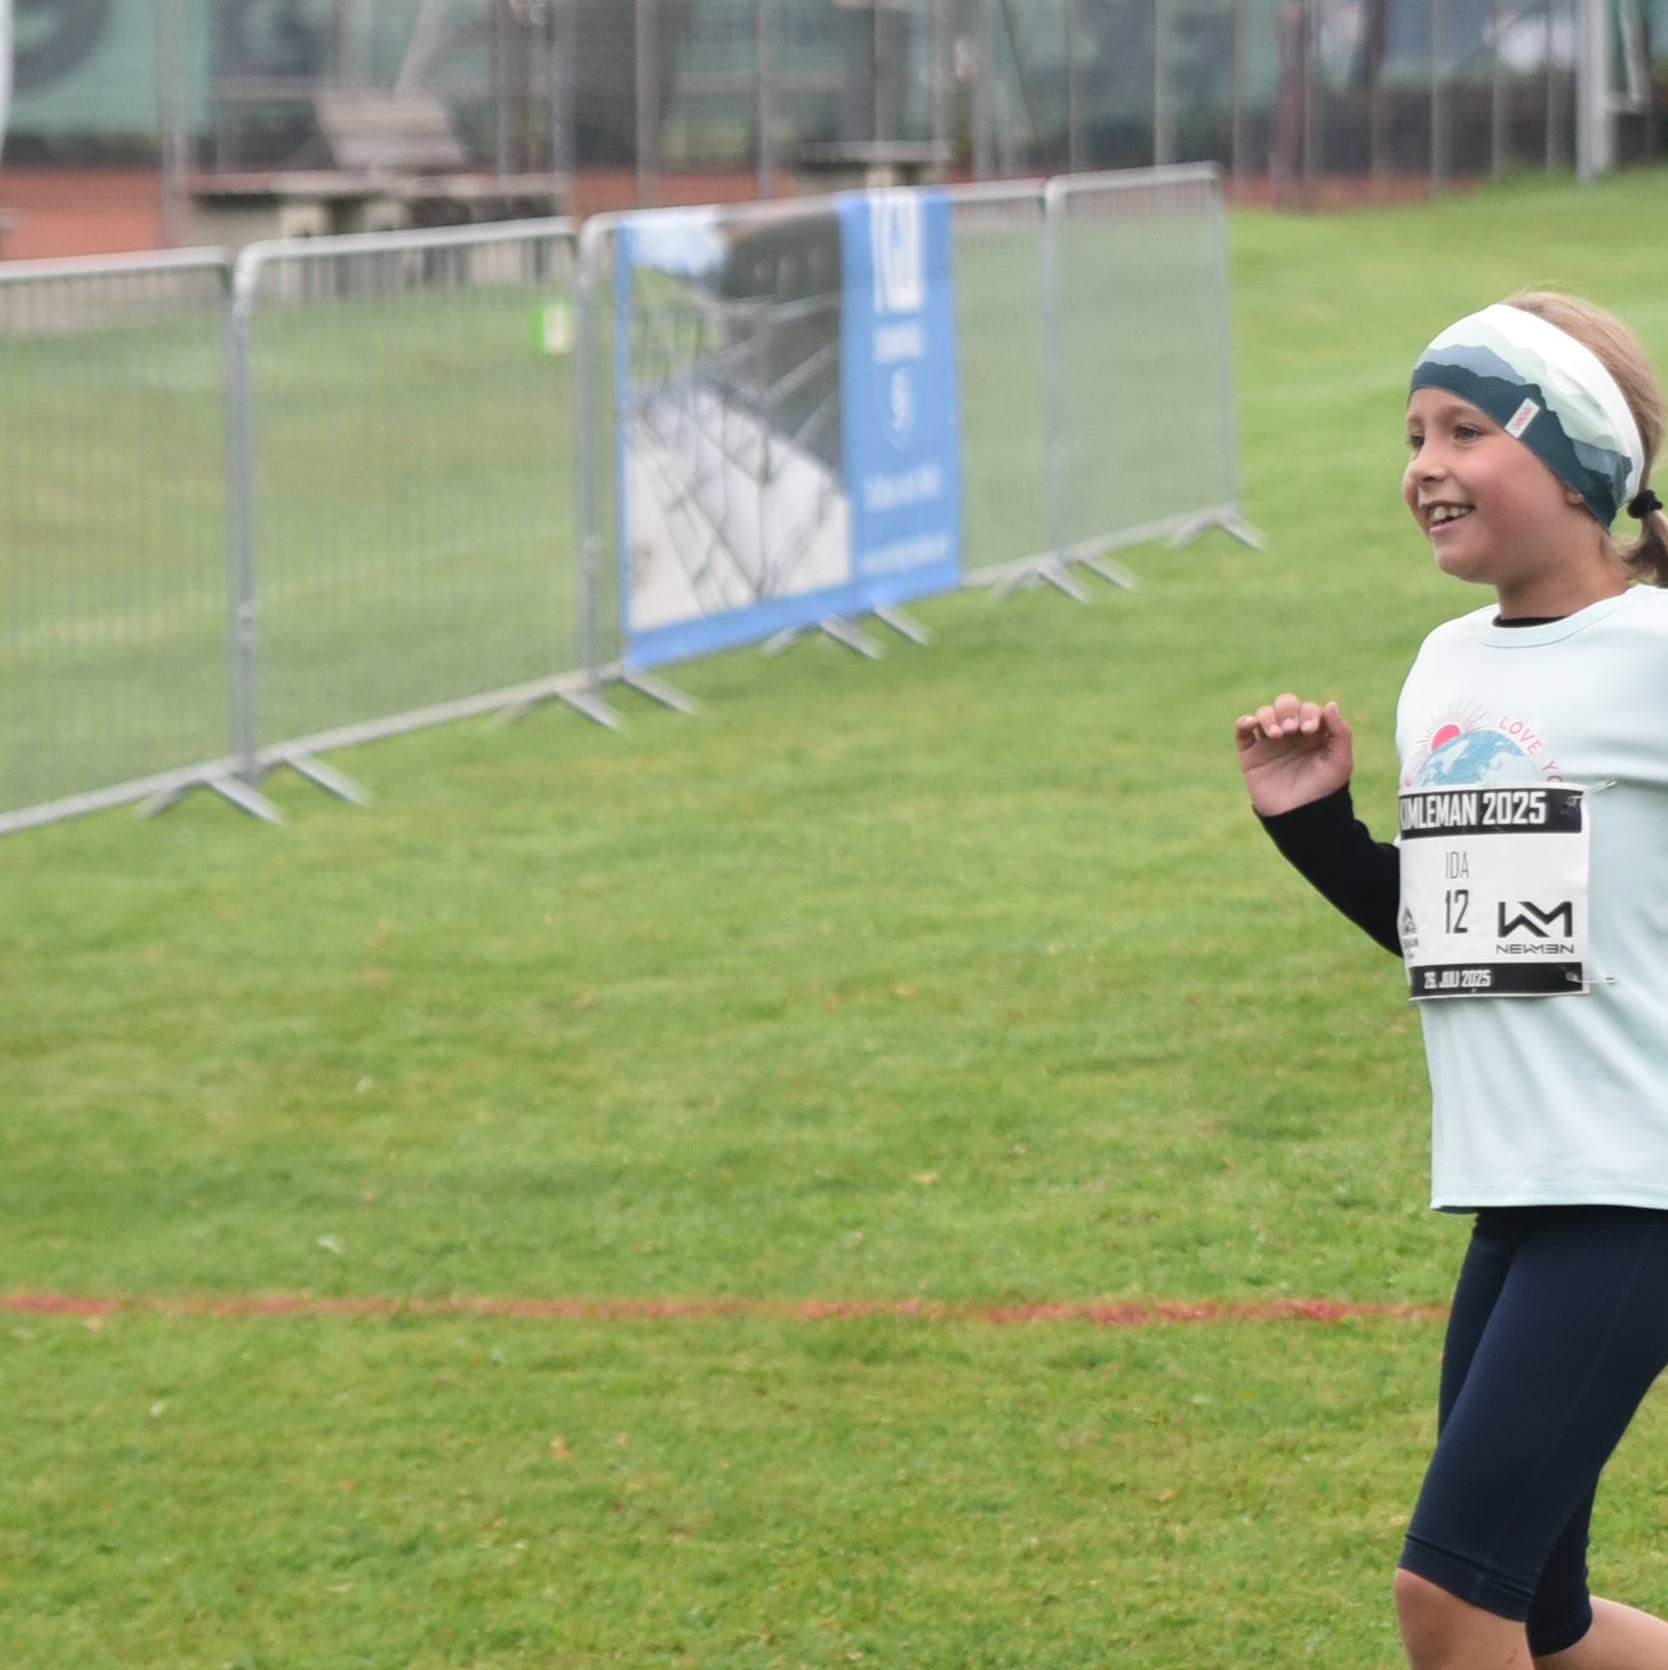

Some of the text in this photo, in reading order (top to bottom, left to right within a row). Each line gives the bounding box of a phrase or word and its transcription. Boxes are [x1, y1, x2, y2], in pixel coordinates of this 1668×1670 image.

[1499, 715, 1543, 754] LOVE
[1482, 791, 1548, 825] 2025
[1445, 851, 1469, 879] IDA
[1445, 889, 1468, 934] 12
[1461, 969, 1491, 987] 2025
